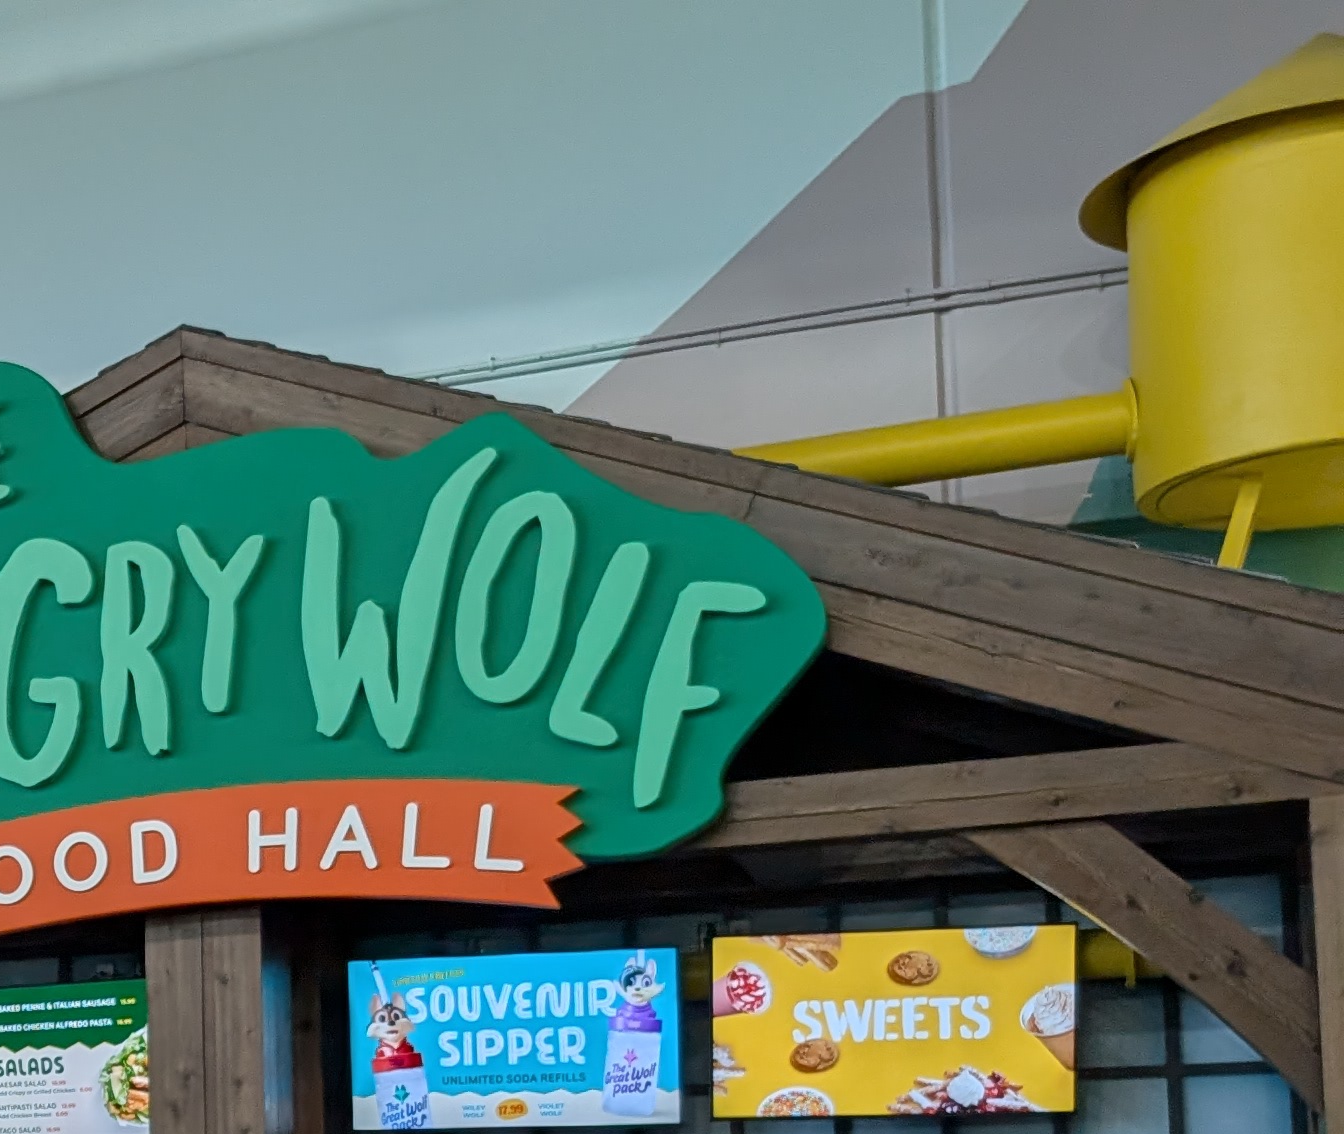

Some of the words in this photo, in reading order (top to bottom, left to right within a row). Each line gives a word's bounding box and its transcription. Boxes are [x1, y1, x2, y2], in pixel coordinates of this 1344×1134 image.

[301, 445, 766, 809] WOLF
[245, 801, 525, 874] HALL
[22, 1002, 45, 1011] PENNE
[53, 1000, 81, 1009] ITALIAN
[82, 998, 116, 1007] SAUSAGE
[405, 979, 617, 1024] SOUVENIR
[0, 1023, 22, 1032] BAKED
[23, 1021, 54, 1031] CHICKEN
[55, 1020, 88, 1029] ALFREDO
[89, 1018, 112, 1027] PASTA
[792, 995, 992, 1043] SWEETS
[438, 1026, 587, 1067] SIPPER
[442, 1074, 503, 1085] UNLIMITED
[506, 1073, 537, 1084] SODA
[541, 1072, 586, 1083] REFILLS
[605, 1071, 629, 1084] Great
[631, 1062, 657, 1080] Wolf
[381, 1108, 405, 1125] Great
[385, 1102, 399, 1113] The
[498, 1104, 524, 1116] 17.99
